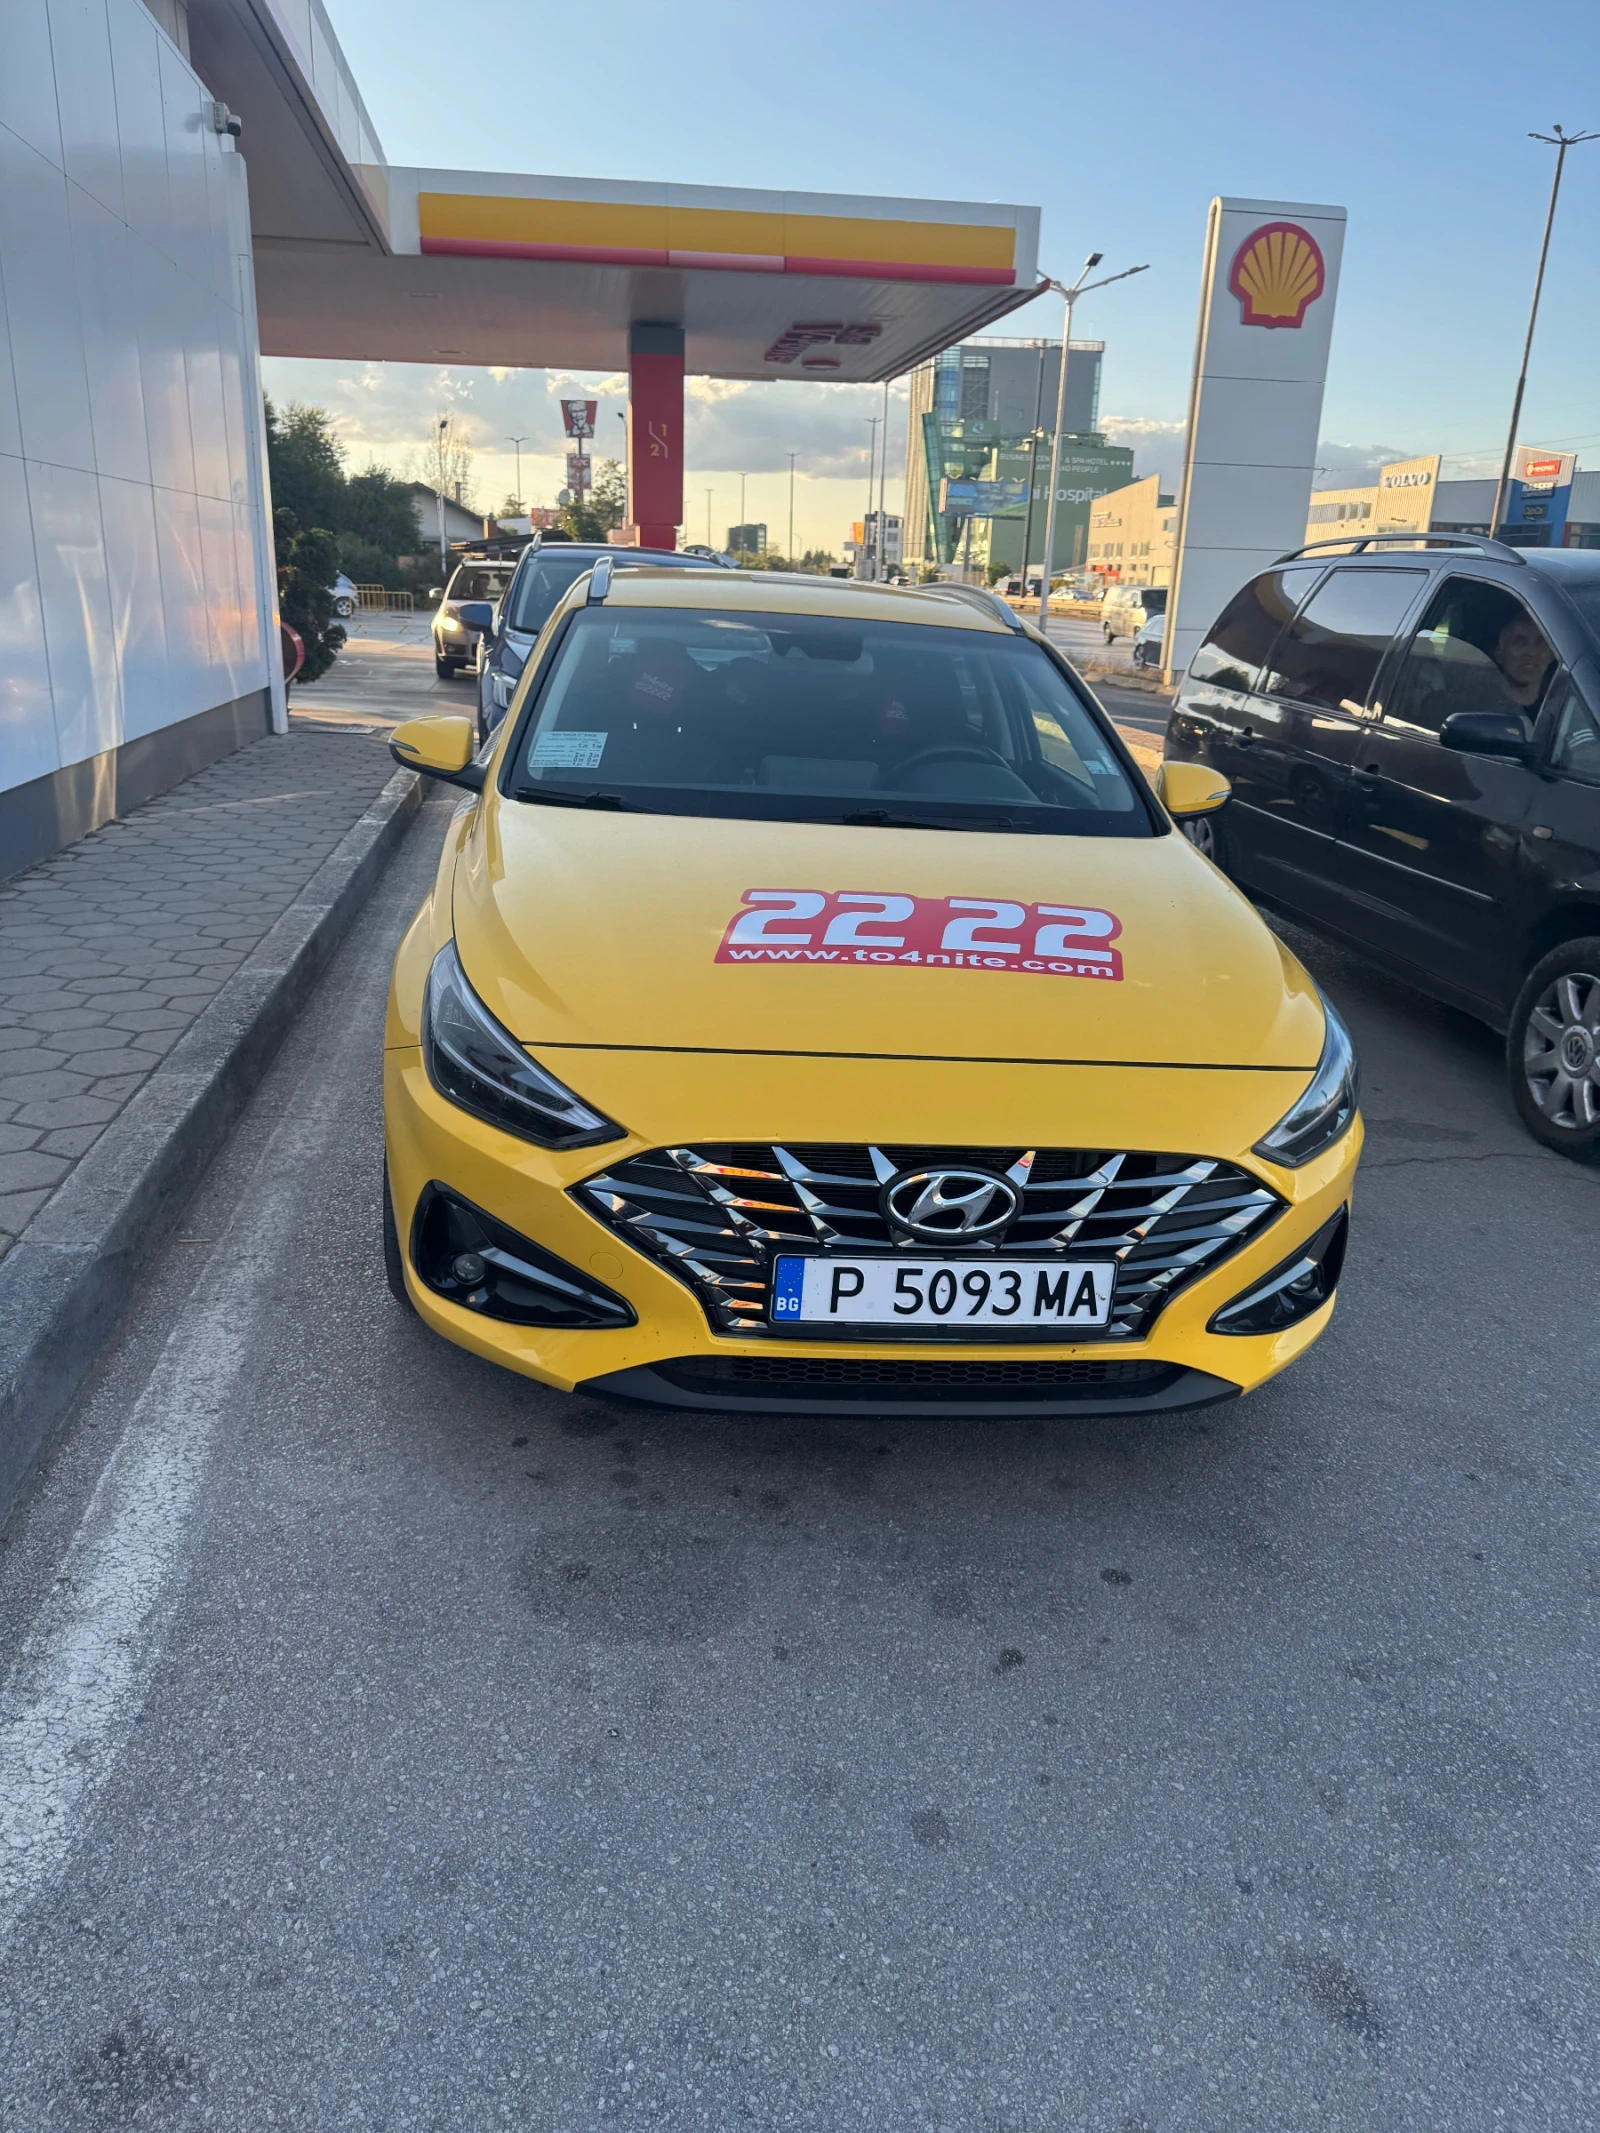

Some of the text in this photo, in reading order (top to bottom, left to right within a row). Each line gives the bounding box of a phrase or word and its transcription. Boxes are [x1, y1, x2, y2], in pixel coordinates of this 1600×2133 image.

[661, 424, 667, 436] 1
[650, 444, 660, 456] 2
[1383, 472, 1431, 488] VOLVO
[728, 891, 1114, 963] 22 22
[728, 949, 1114, 977] www.to4nite.com
[830, 1266, 1098, 1317] P 5093 MA
[776, 1297, 799, 1312] BG
